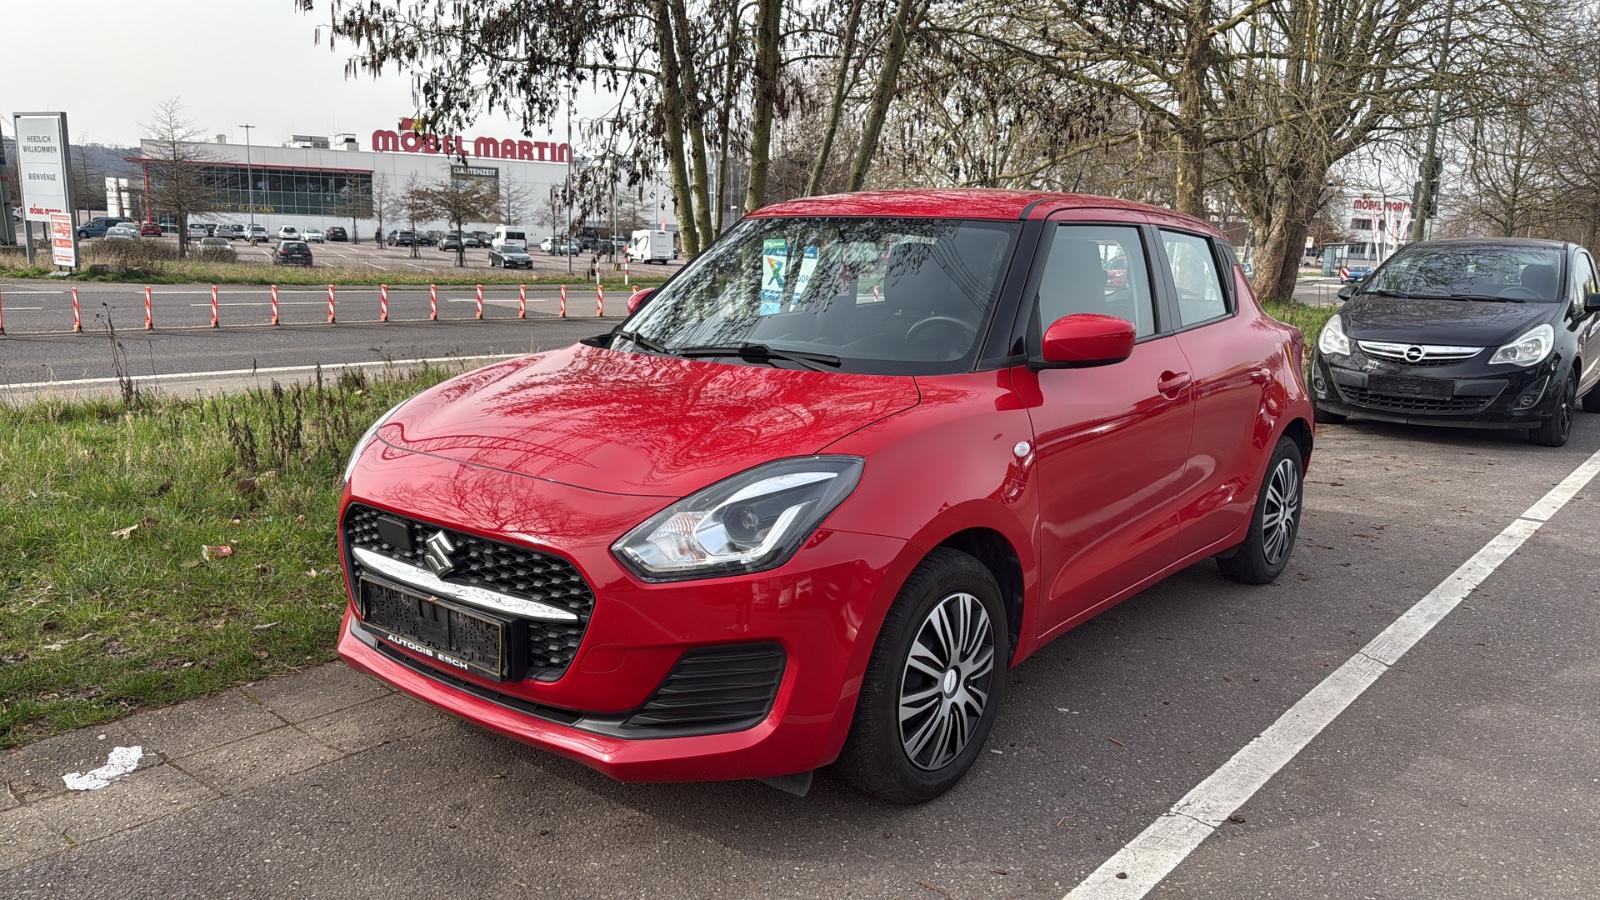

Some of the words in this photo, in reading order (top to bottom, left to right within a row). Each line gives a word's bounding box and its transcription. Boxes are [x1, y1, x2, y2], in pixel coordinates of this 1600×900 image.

[26, 135, 51, 143] HERZLICH
[23, 145, 57, 153] WILLKOMMEN
[474, 136, 573, 162] MARTIN
[28, 173, 56, 181] BIENVENUE
[387, 635, 433, 657] AUTODIS
[437, 653, 468, 671] ESCH
